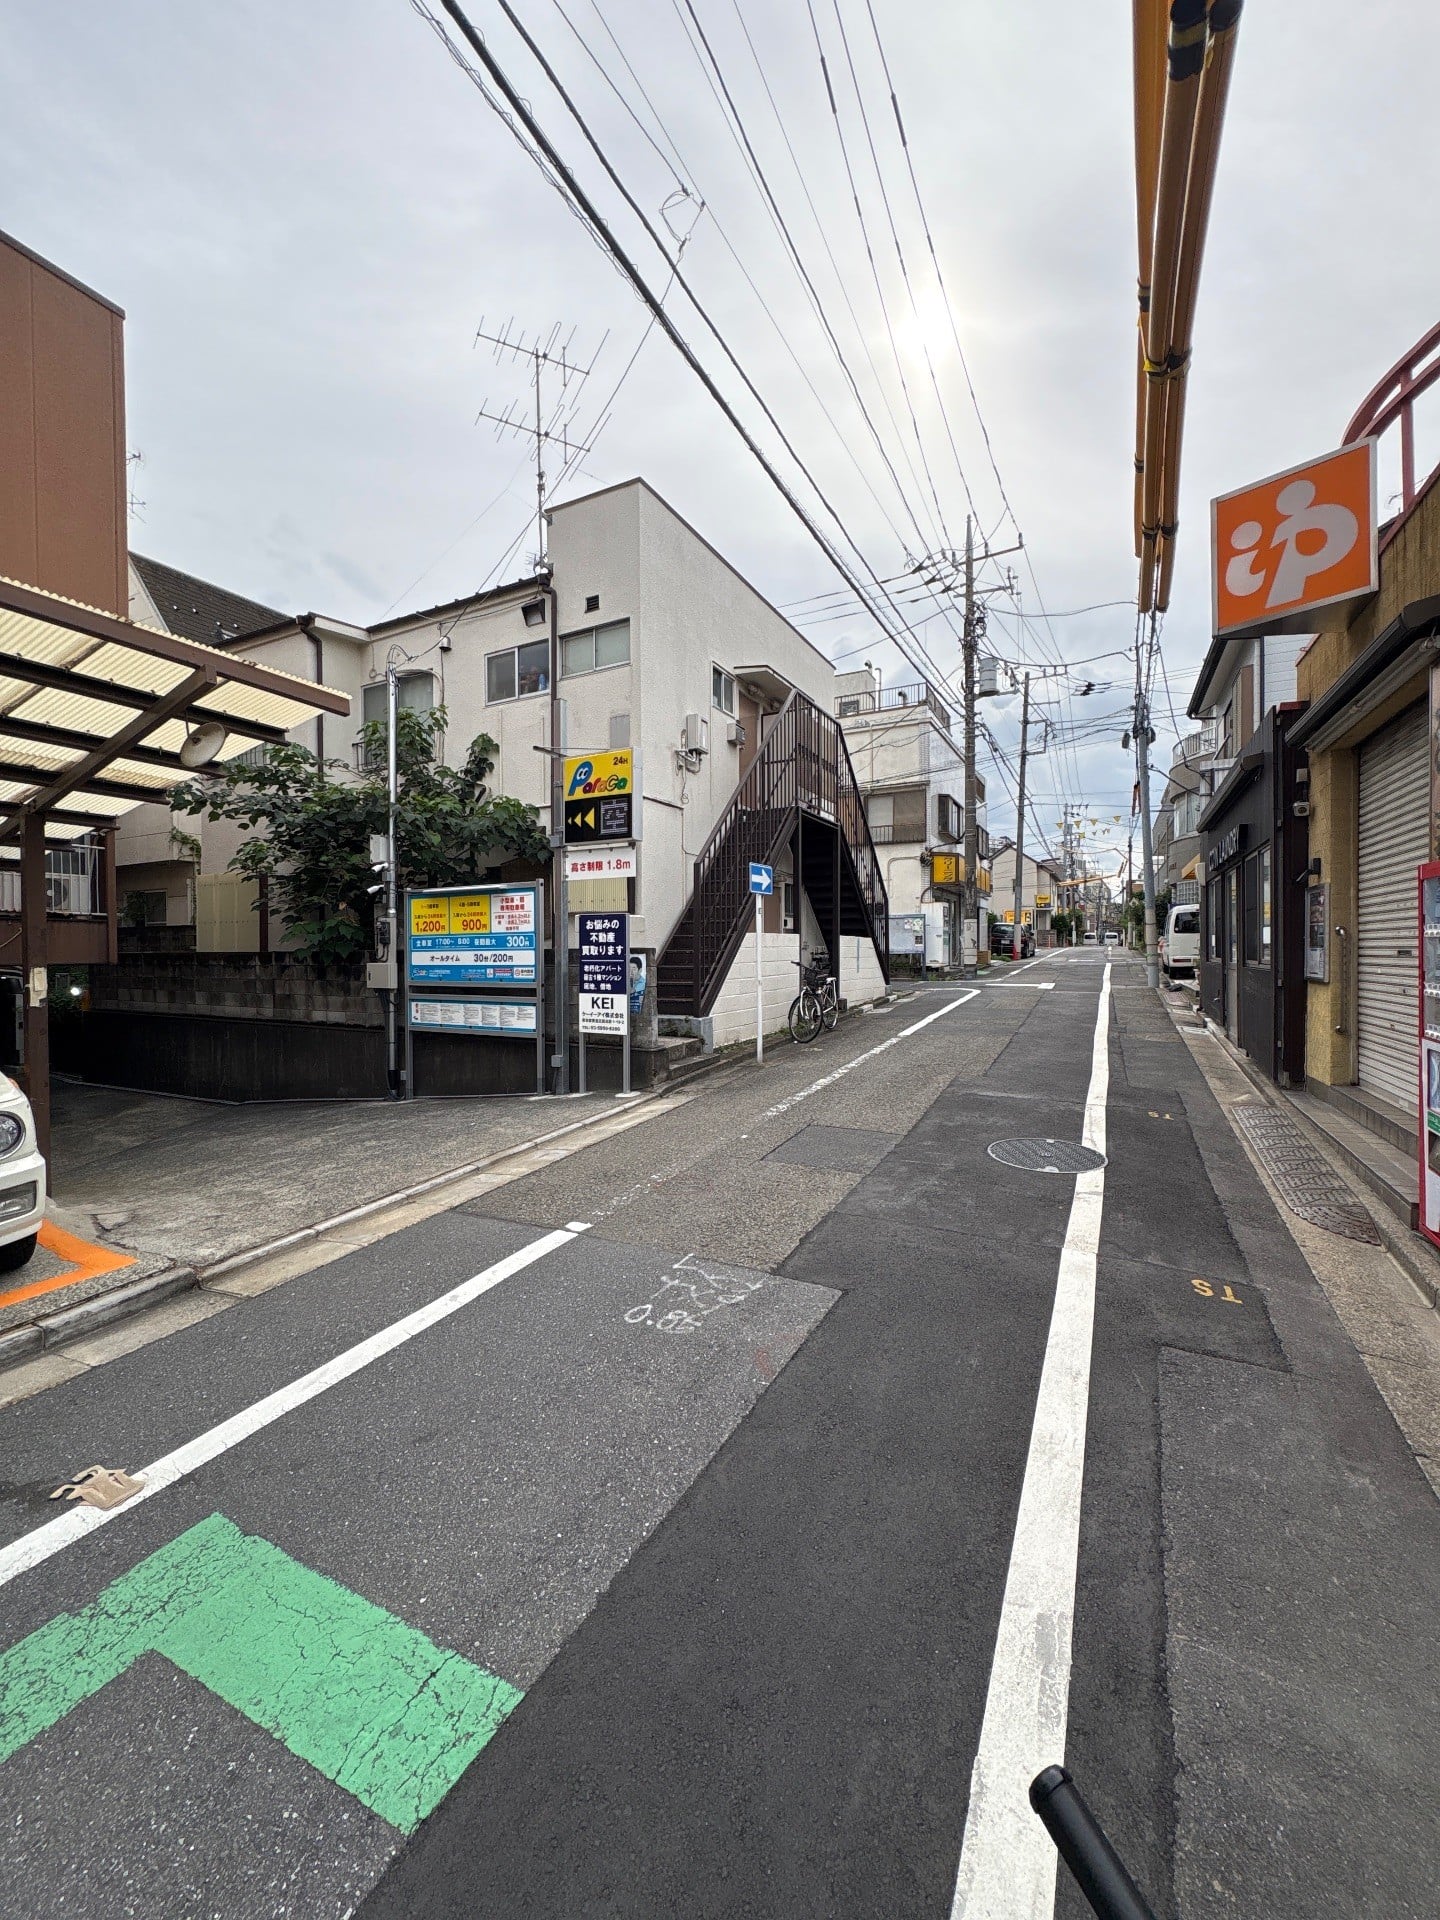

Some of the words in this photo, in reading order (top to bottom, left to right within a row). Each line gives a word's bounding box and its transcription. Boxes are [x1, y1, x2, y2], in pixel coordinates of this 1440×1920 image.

[1225, 480, 1359, 608] ip
[570, 860, 604, 873] 高さ制限
[606, 859, 631, 871] 1.8m
[415, 920, 446, 933] 1,200円
[461, 918, 488, 931] 900円
[585, 919, 620, 930] お悩みの
[589, 932, 616, 943] 不動産
[581, 945, 624, 956] 買取ります
[429, 954, 461, 962] オールタイム
[591, 996, 614, 1010] KEI
